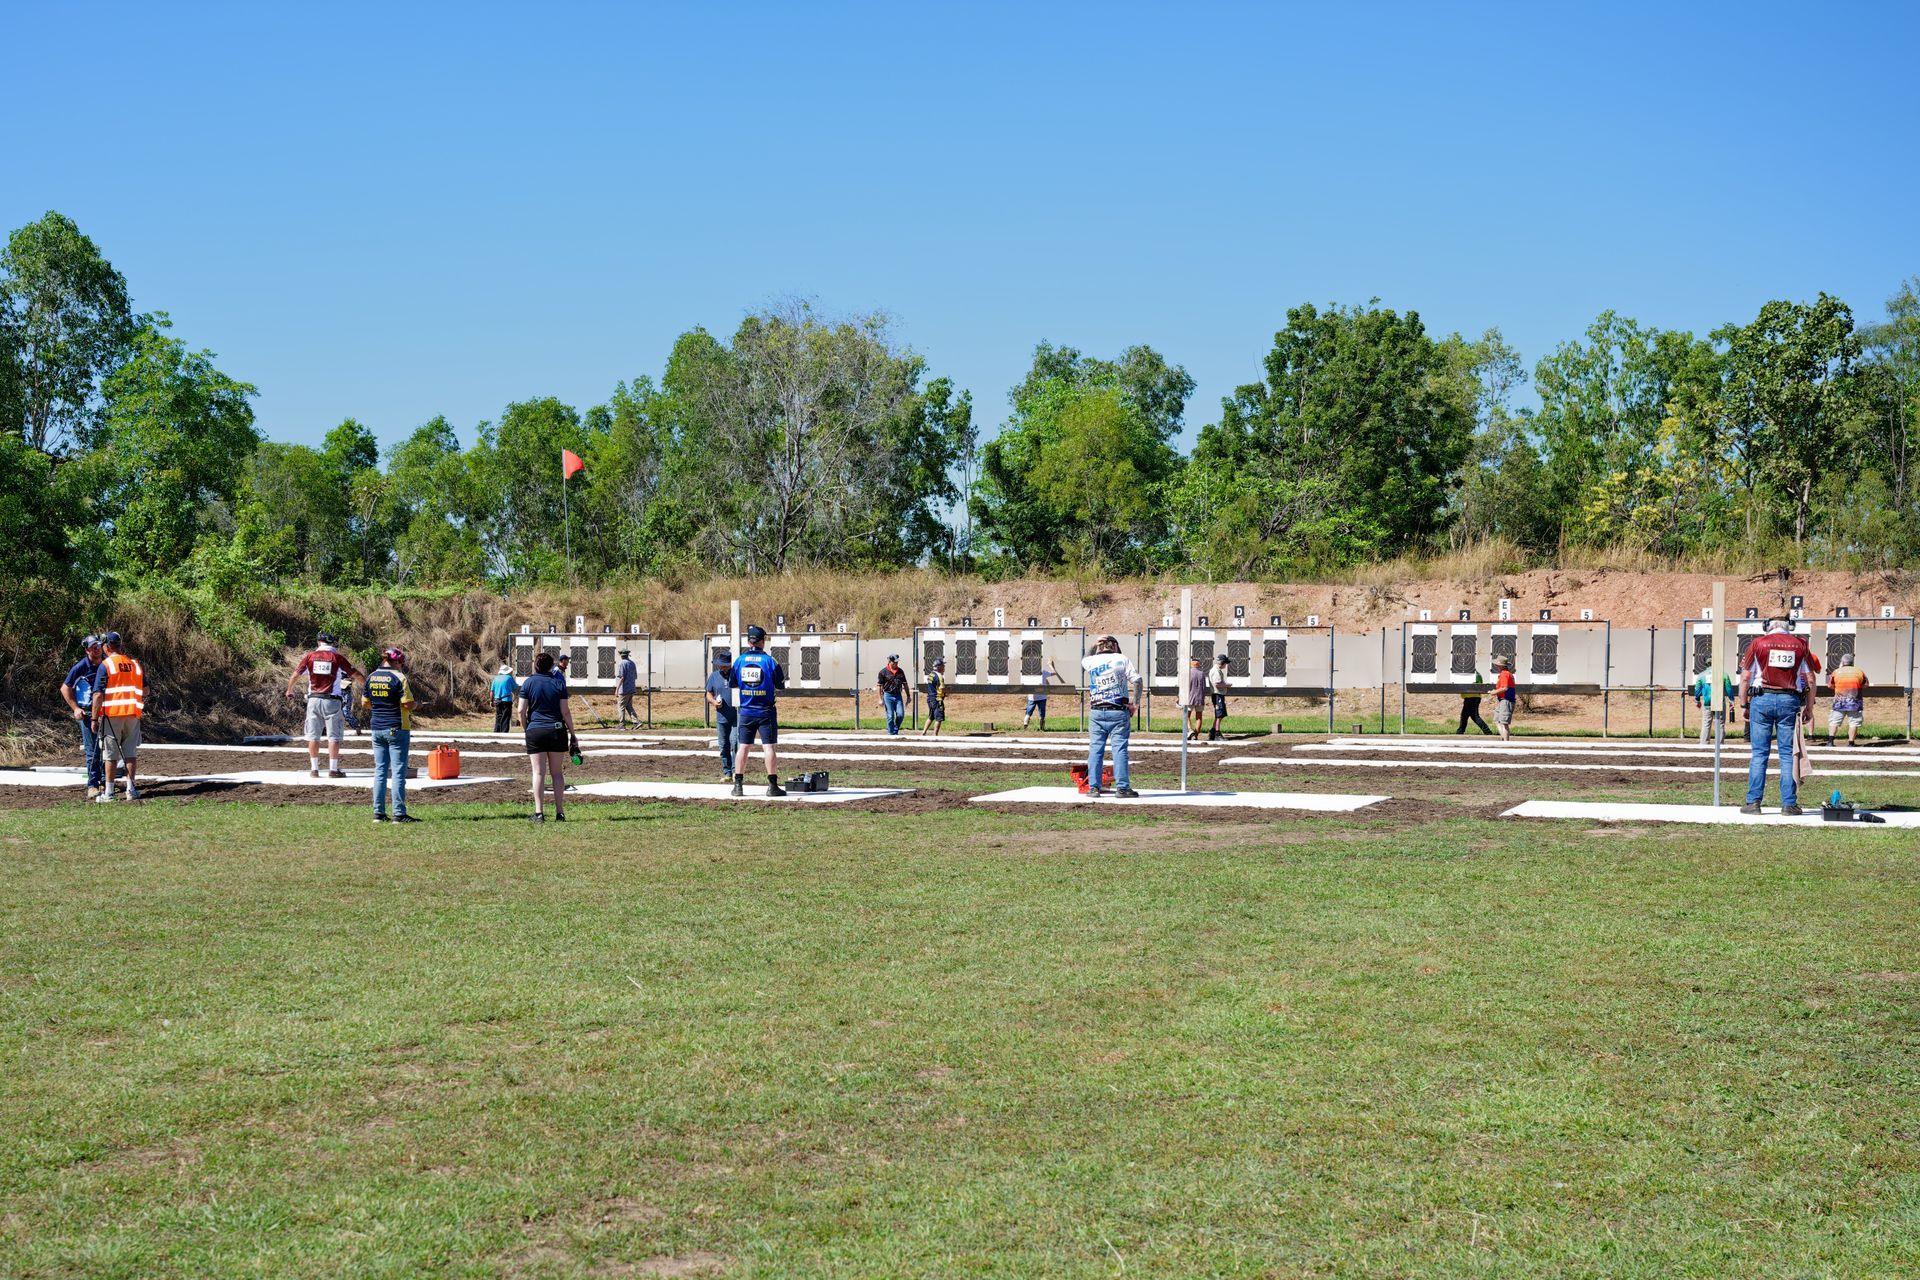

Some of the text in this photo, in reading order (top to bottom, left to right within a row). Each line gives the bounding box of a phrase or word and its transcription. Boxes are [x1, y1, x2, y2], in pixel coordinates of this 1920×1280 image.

[1502, 602, 1508, 610] E
[1794, 598, 1800, 606] F
[1502, 612, 1508, 620] 3
[1542, 612, 1548, 620] 4
[1584, 612, 1590, 620] 5
[1748, 610, 1755, 618] 2
[1794, 610, 1800, 618] 3
[1838, 609, 1846, 618] 4
[1885, 608, 1890, 617] 5
[1310, 618, 1316, 626] 5
[1777, 655, 1793, 663] 132
[118, 662, 132, 672] CAT
[1102, 676, 1116, 686] 075
